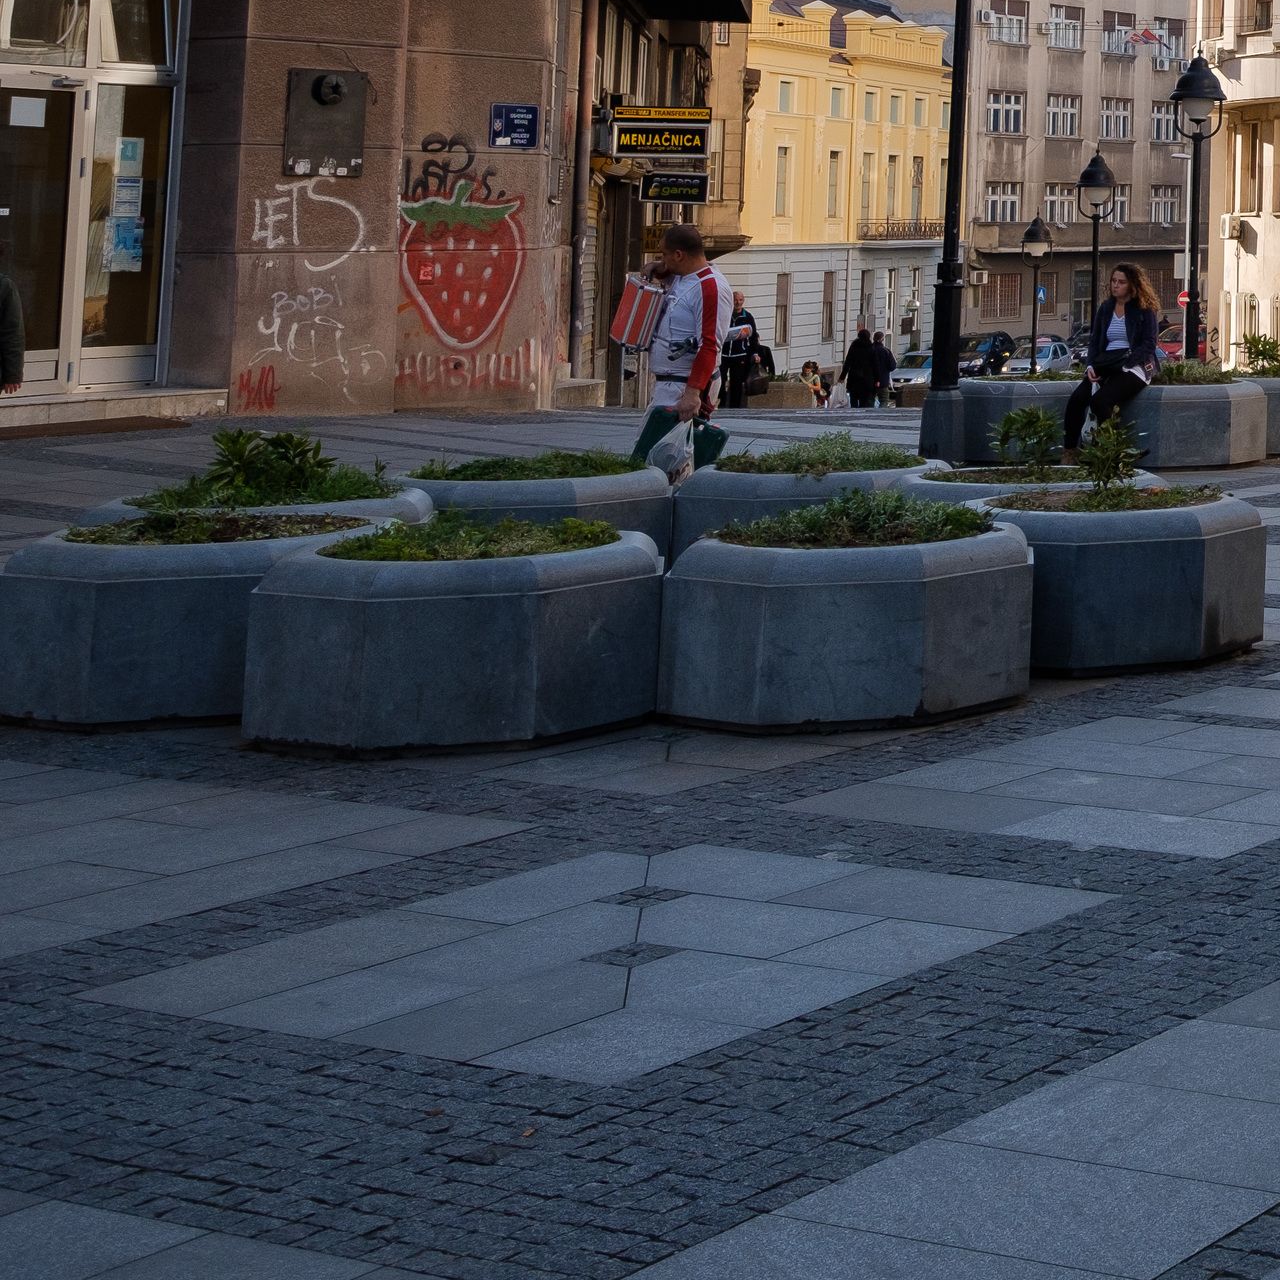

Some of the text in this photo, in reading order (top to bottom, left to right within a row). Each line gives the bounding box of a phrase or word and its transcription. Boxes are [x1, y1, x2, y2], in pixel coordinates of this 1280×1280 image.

[688, 110, 710, 118] NOVCA
[620, 131, 701, 147] MENJAČNICA
[661, 186, 700, 196] game
